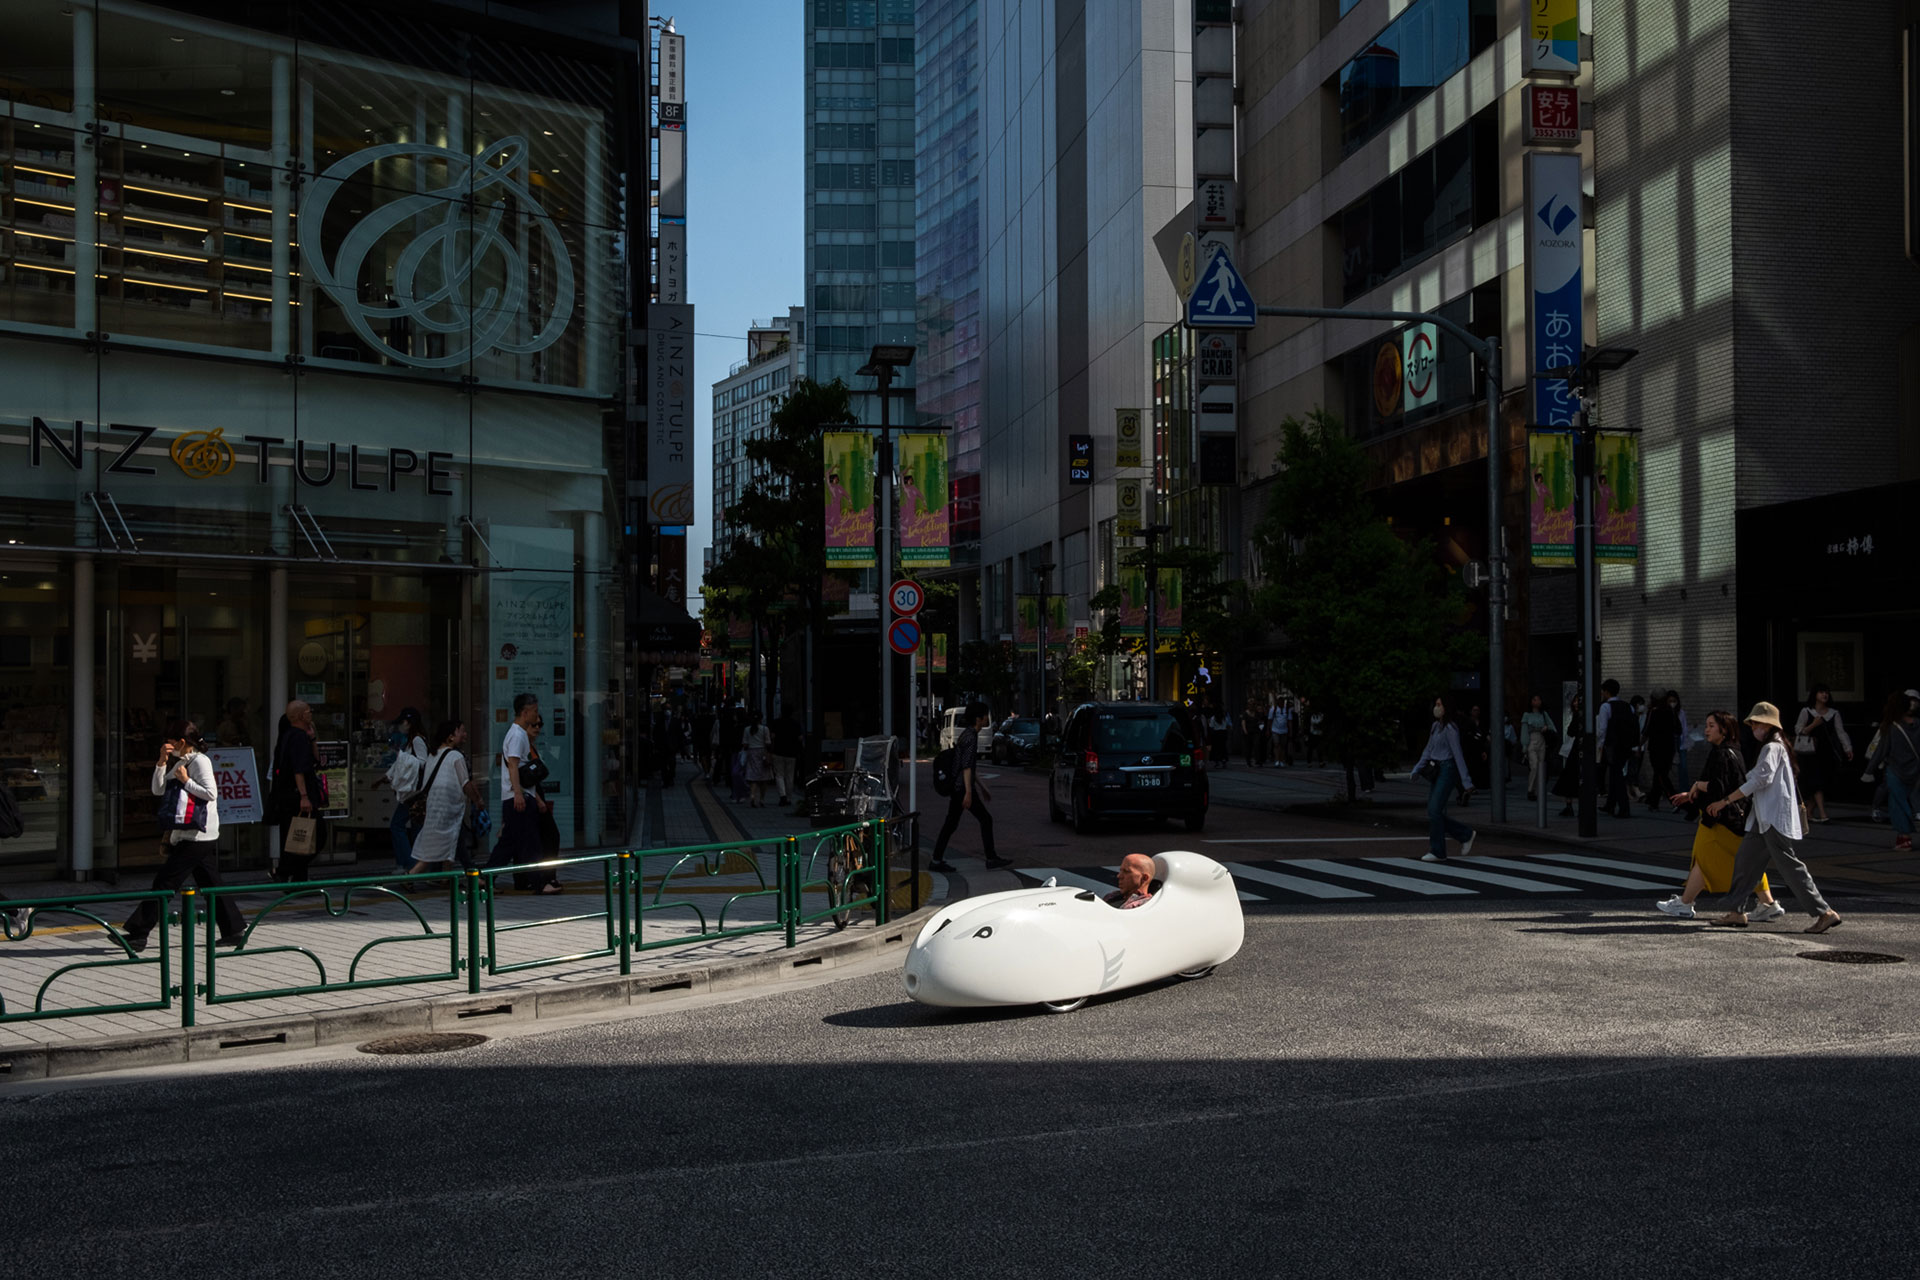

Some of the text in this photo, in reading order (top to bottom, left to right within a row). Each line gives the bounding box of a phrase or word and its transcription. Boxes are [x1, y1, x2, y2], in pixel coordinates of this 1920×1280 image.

[1537, 91, 1571, 110] 安与
[665, 105, 680, 117] 8F
[1539, 109, 1572, 127] ビル
[1535, 129, 1576, 138] 3352-5115
[1539, 239, 1576, 249] AOZORA
[667, 241, 678, 302] ホットヨガ
[656, 334, 665, 362] DRUG
[1201, 359, 1233, 376] CRAB
[1406, 356, 1435, 380] スシロー
[669, 316, 684, 463] AINZ TULPE
[656, 391, 665, 445] COSMETIC
[244, 434, 454, 497] TULPE
[496, 600, 526, 609] AINZ
[897, 590, 916, 606] 30
[132, 632, 158, 663] ¥
[213, 769, 247, 785] TAX
